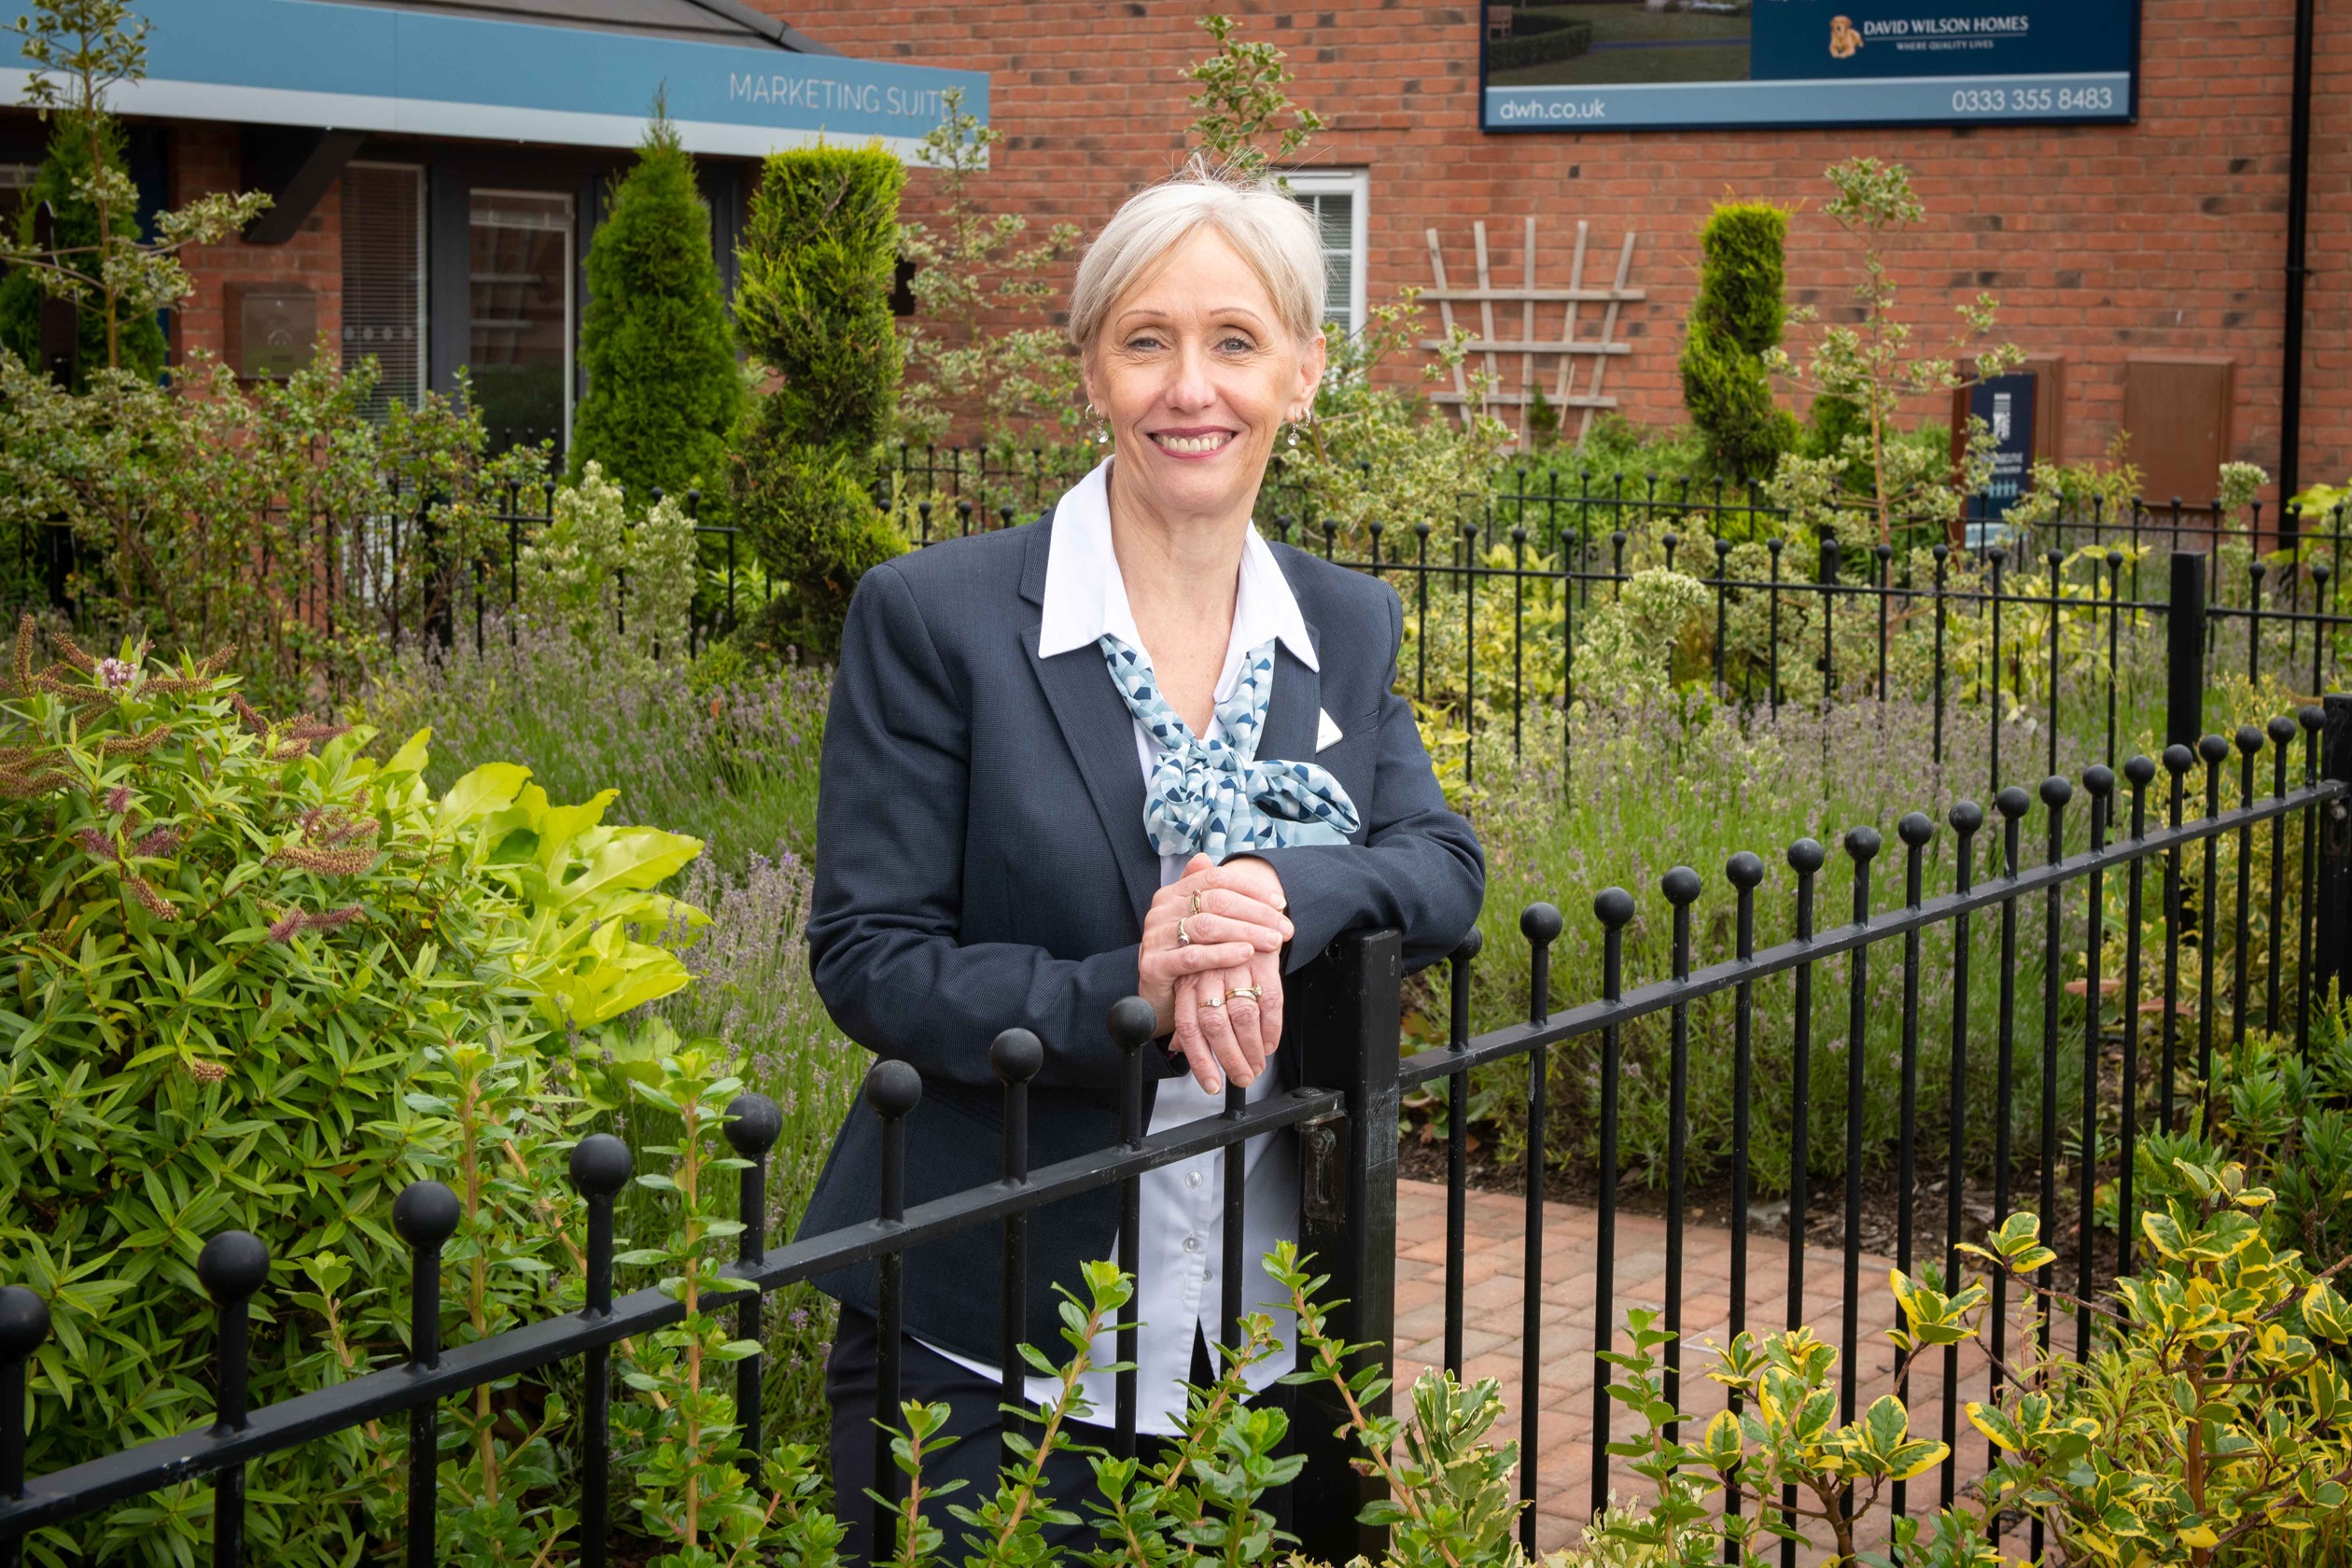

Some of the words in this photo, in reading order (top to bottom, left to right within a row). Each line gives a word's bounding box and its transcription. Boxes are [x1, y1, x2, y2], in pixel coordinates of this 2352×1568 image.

[1864, 21, 1909, 35] DAVID
[1911, 18, 1970, 34] WILSON
[1973, 15, 2029, 32] HOMES
[1896, 41, 1927, 50] WHERE
[1928, 40, 1967, 50] QUALITY
[730, 72, 880, 113] MARKETING
[1952, 90, 2006, 112] 0333
[2011, 88, 2052, 111] 355
[2057, 87, 2113, 110] 8483
[1500, 98, 1605, 119] dwh.co.uk
